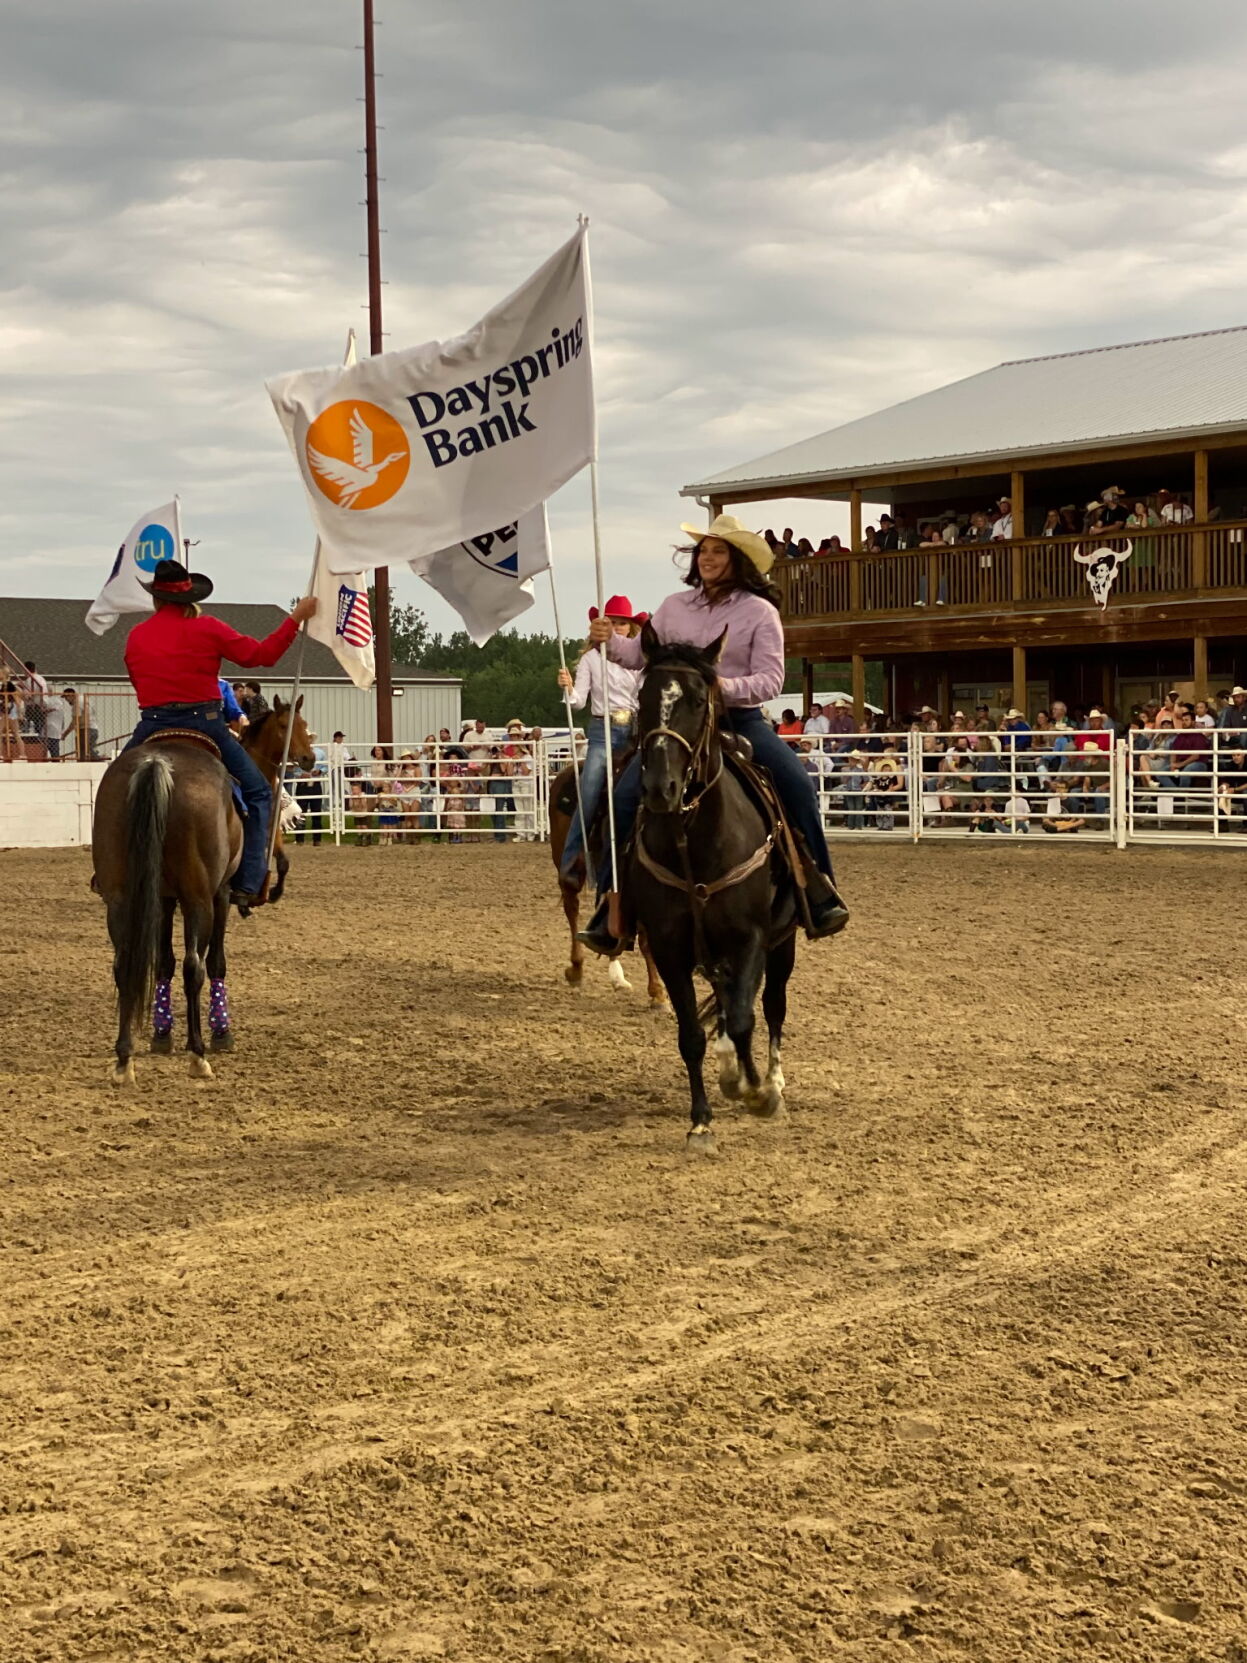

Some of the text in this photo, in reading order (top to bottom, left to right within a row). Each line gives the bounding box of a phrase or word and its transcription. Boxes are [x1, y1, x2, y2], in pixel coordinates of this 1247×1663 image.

[406, 315, 583, 428] Dayspring
[422, 401, 537, 468] Bank
[471, 520, 518, 556] PE
[340, 593, 353, 631] PACIFIC
